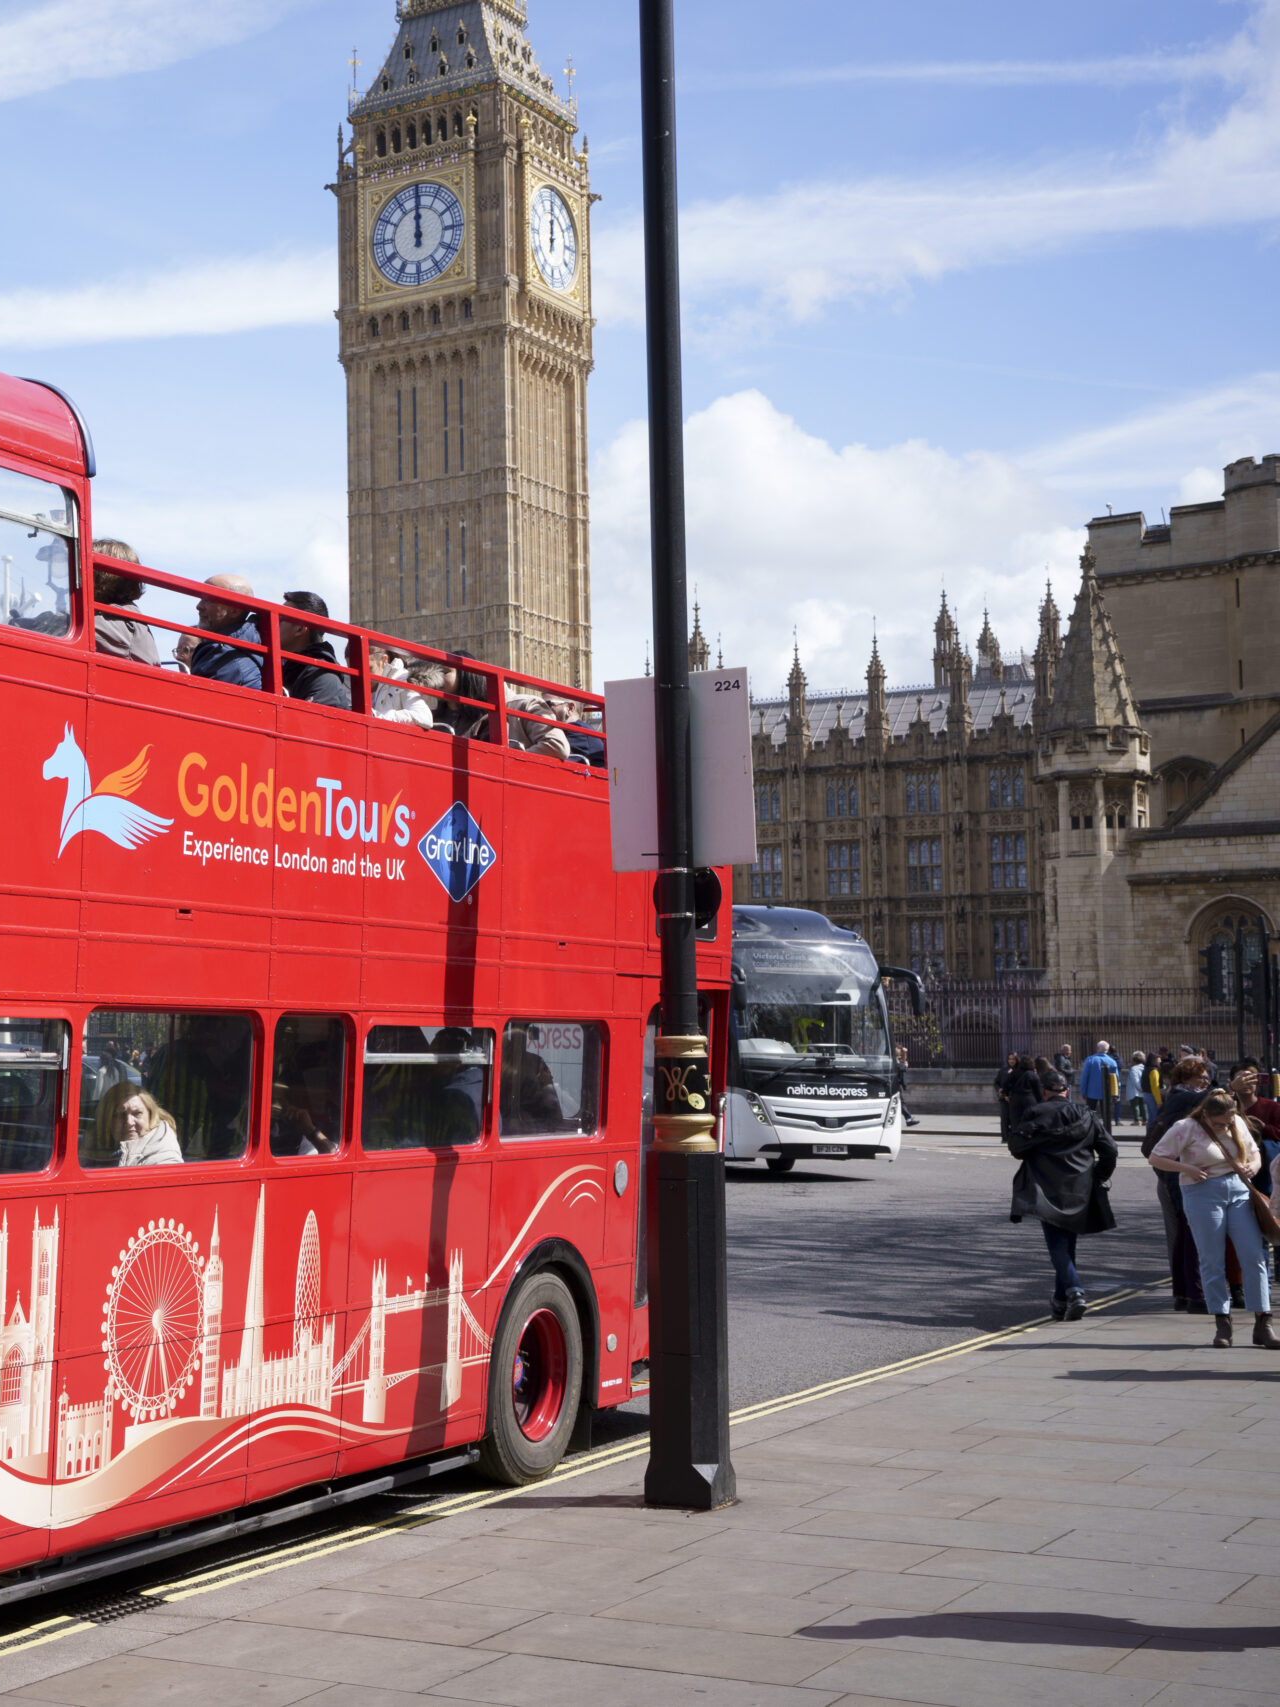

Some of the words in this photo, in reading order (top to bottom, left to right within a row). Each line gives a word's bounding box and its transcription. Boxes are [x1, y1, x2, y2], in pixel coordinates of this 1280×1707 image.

[714, 679, 741, 692] 224
[178, 752, 411, 847] GoldenTours
[183, 830, 269, 866] Experience
[275, 843, 327, 873] London
[332, 852, 356, 876] and
[360, 854, 381, 878] the
[386, 858, 406, 880] UK
[787, 1084, 828, 1096] national
[828, 1086, 868, 1099] express
